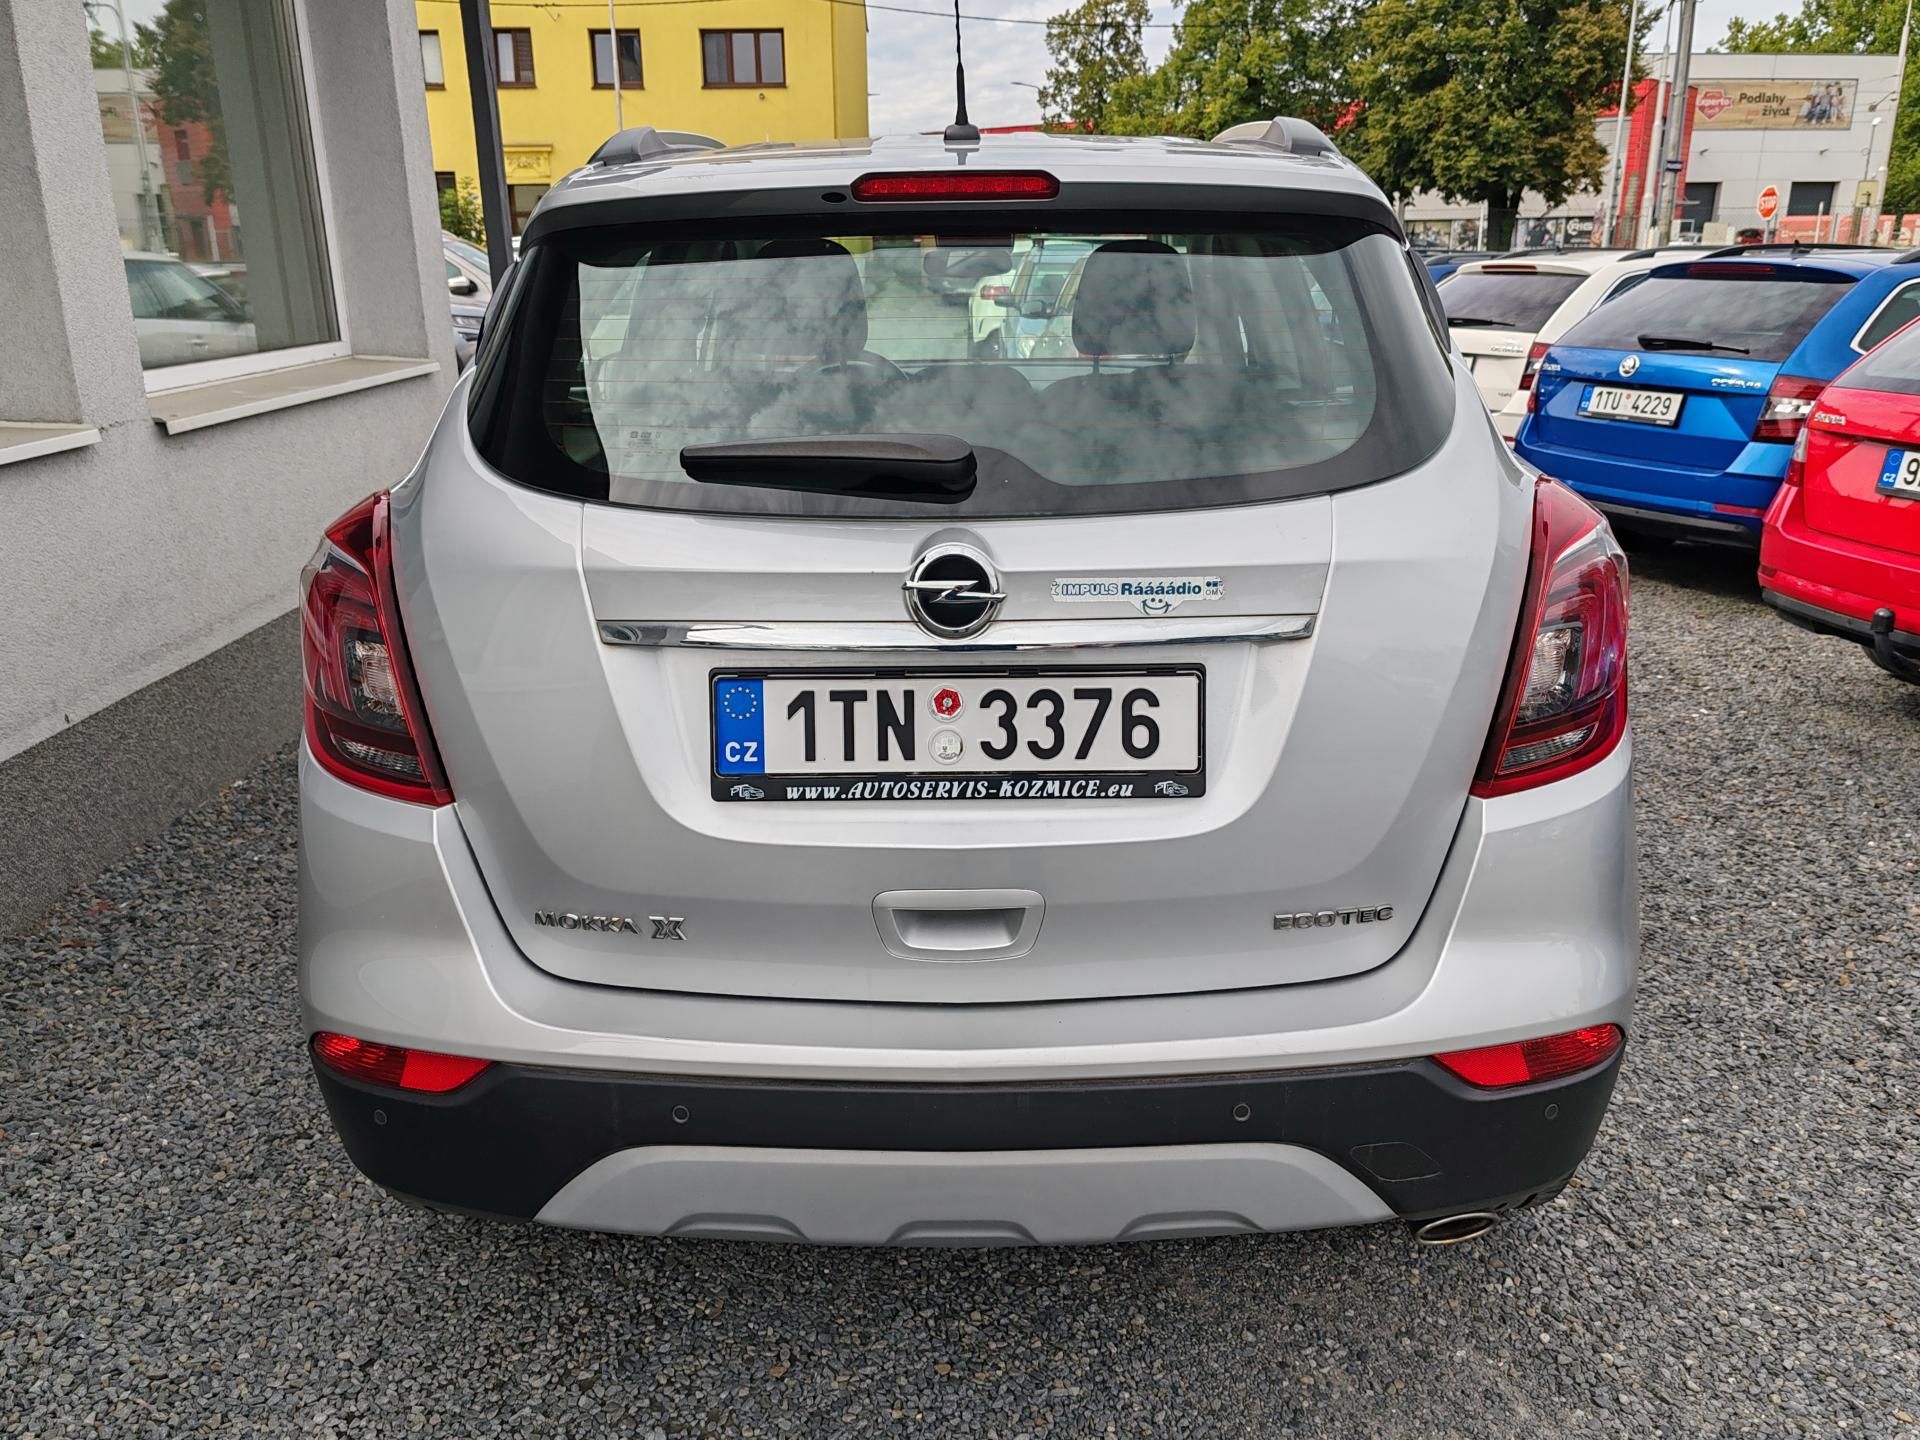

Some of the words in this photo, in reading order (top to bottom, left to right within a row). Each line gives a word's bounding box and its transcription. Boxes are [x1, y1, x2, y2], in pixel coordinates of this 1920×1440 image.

[1738, 92, 1786, 105] Podlahy
[1761, 106, 1791, 117] život
[1759, 196, 1777, 210] STOP
[1595, 391, 1623, 411] 1TU
[1631, 394, 1673, 416] 4229
[1882, 472, 1897, 482] CZ
[1903, 458, 1920, 487] 9
[1061, 582, 1119, 596] IMPULS
[1120, 581, 1202, 596] Ráááádio
[786, 689, 916, 762] 1TN
[979, 687, 1161, 761] 3376
[724, 740, 758, 763] CZ
[785, 780, 1134, 799] www.AUTOSERVIS-KOZMICE.eu
[534, 910, 643, 935] MOKKA
[648, 915, 688, 941] X
[1273, 903, 1394, 930] ECOTEC
